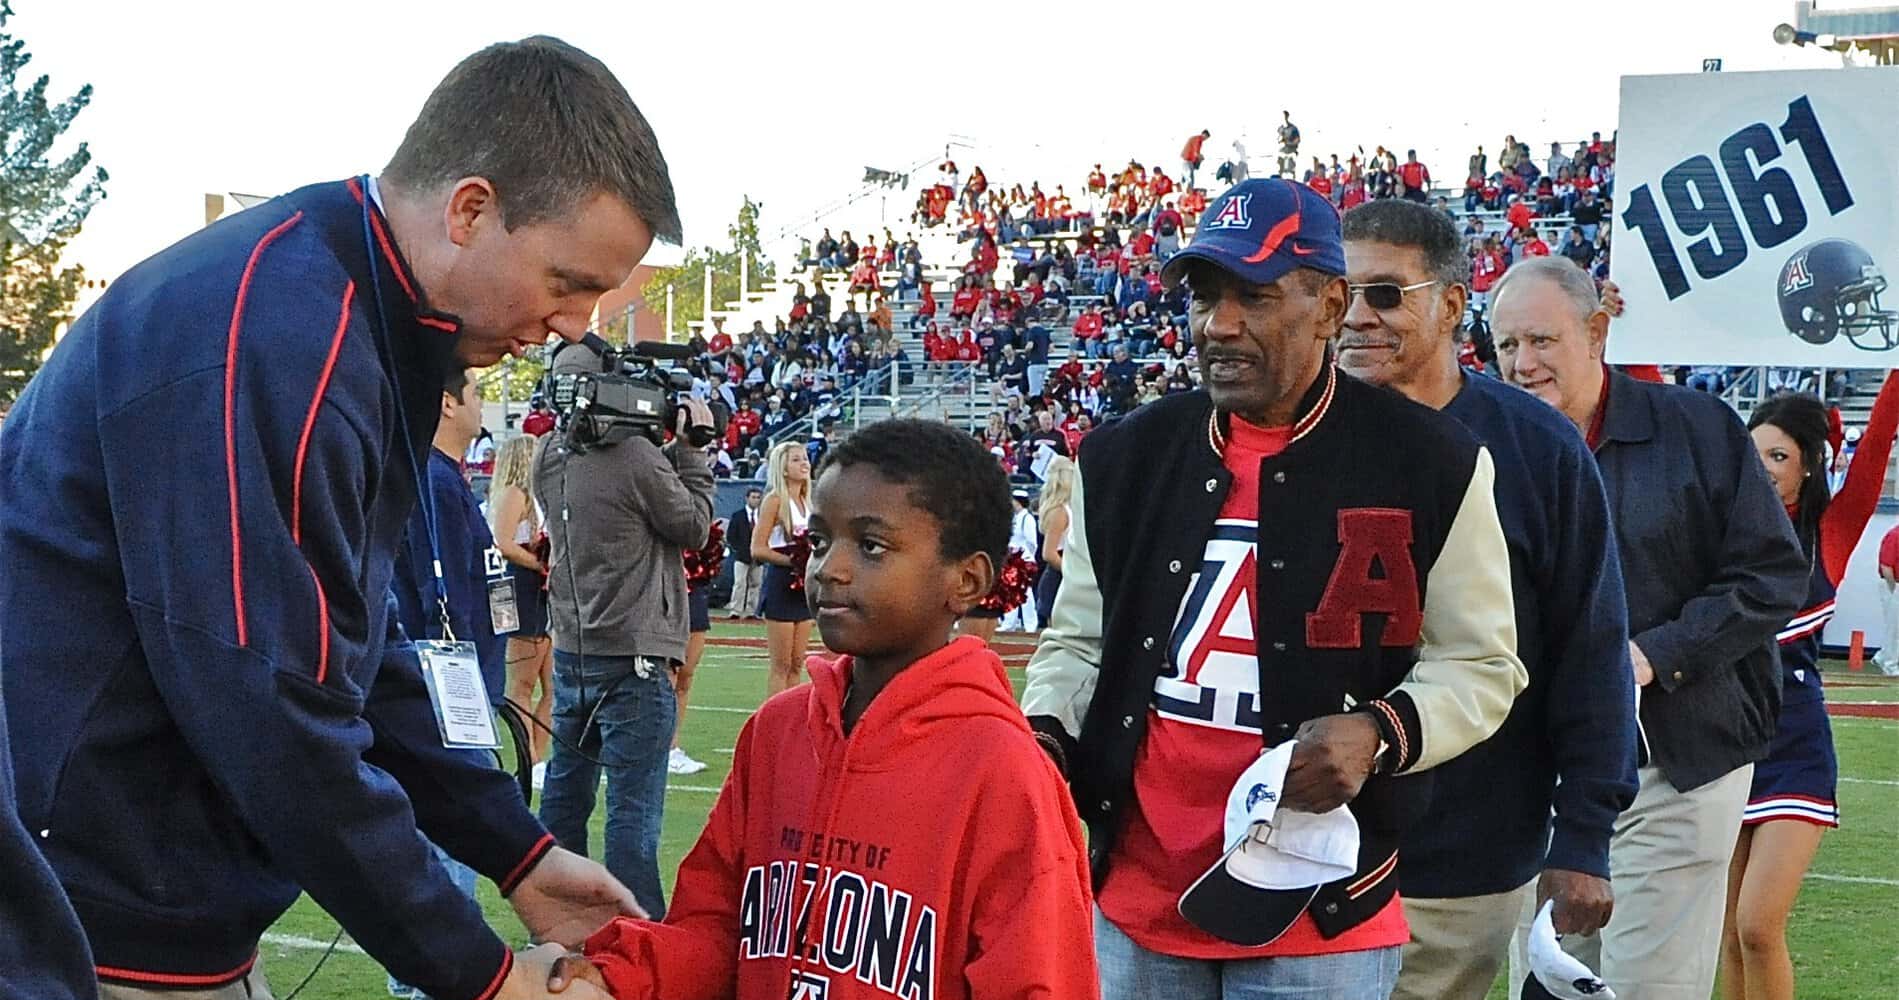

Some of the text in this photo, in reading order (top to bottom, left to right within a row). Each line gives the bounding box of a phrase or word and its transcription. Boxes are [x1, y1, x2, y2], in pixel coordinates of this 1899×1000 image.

[1204, 193, 1252, 231] A
[1622, 94, 1854, 301] 1961
[1783, 253, 1814, 296] A
[1305, 507, 1424, 648] A
[866, 843, 891, 870] OF
